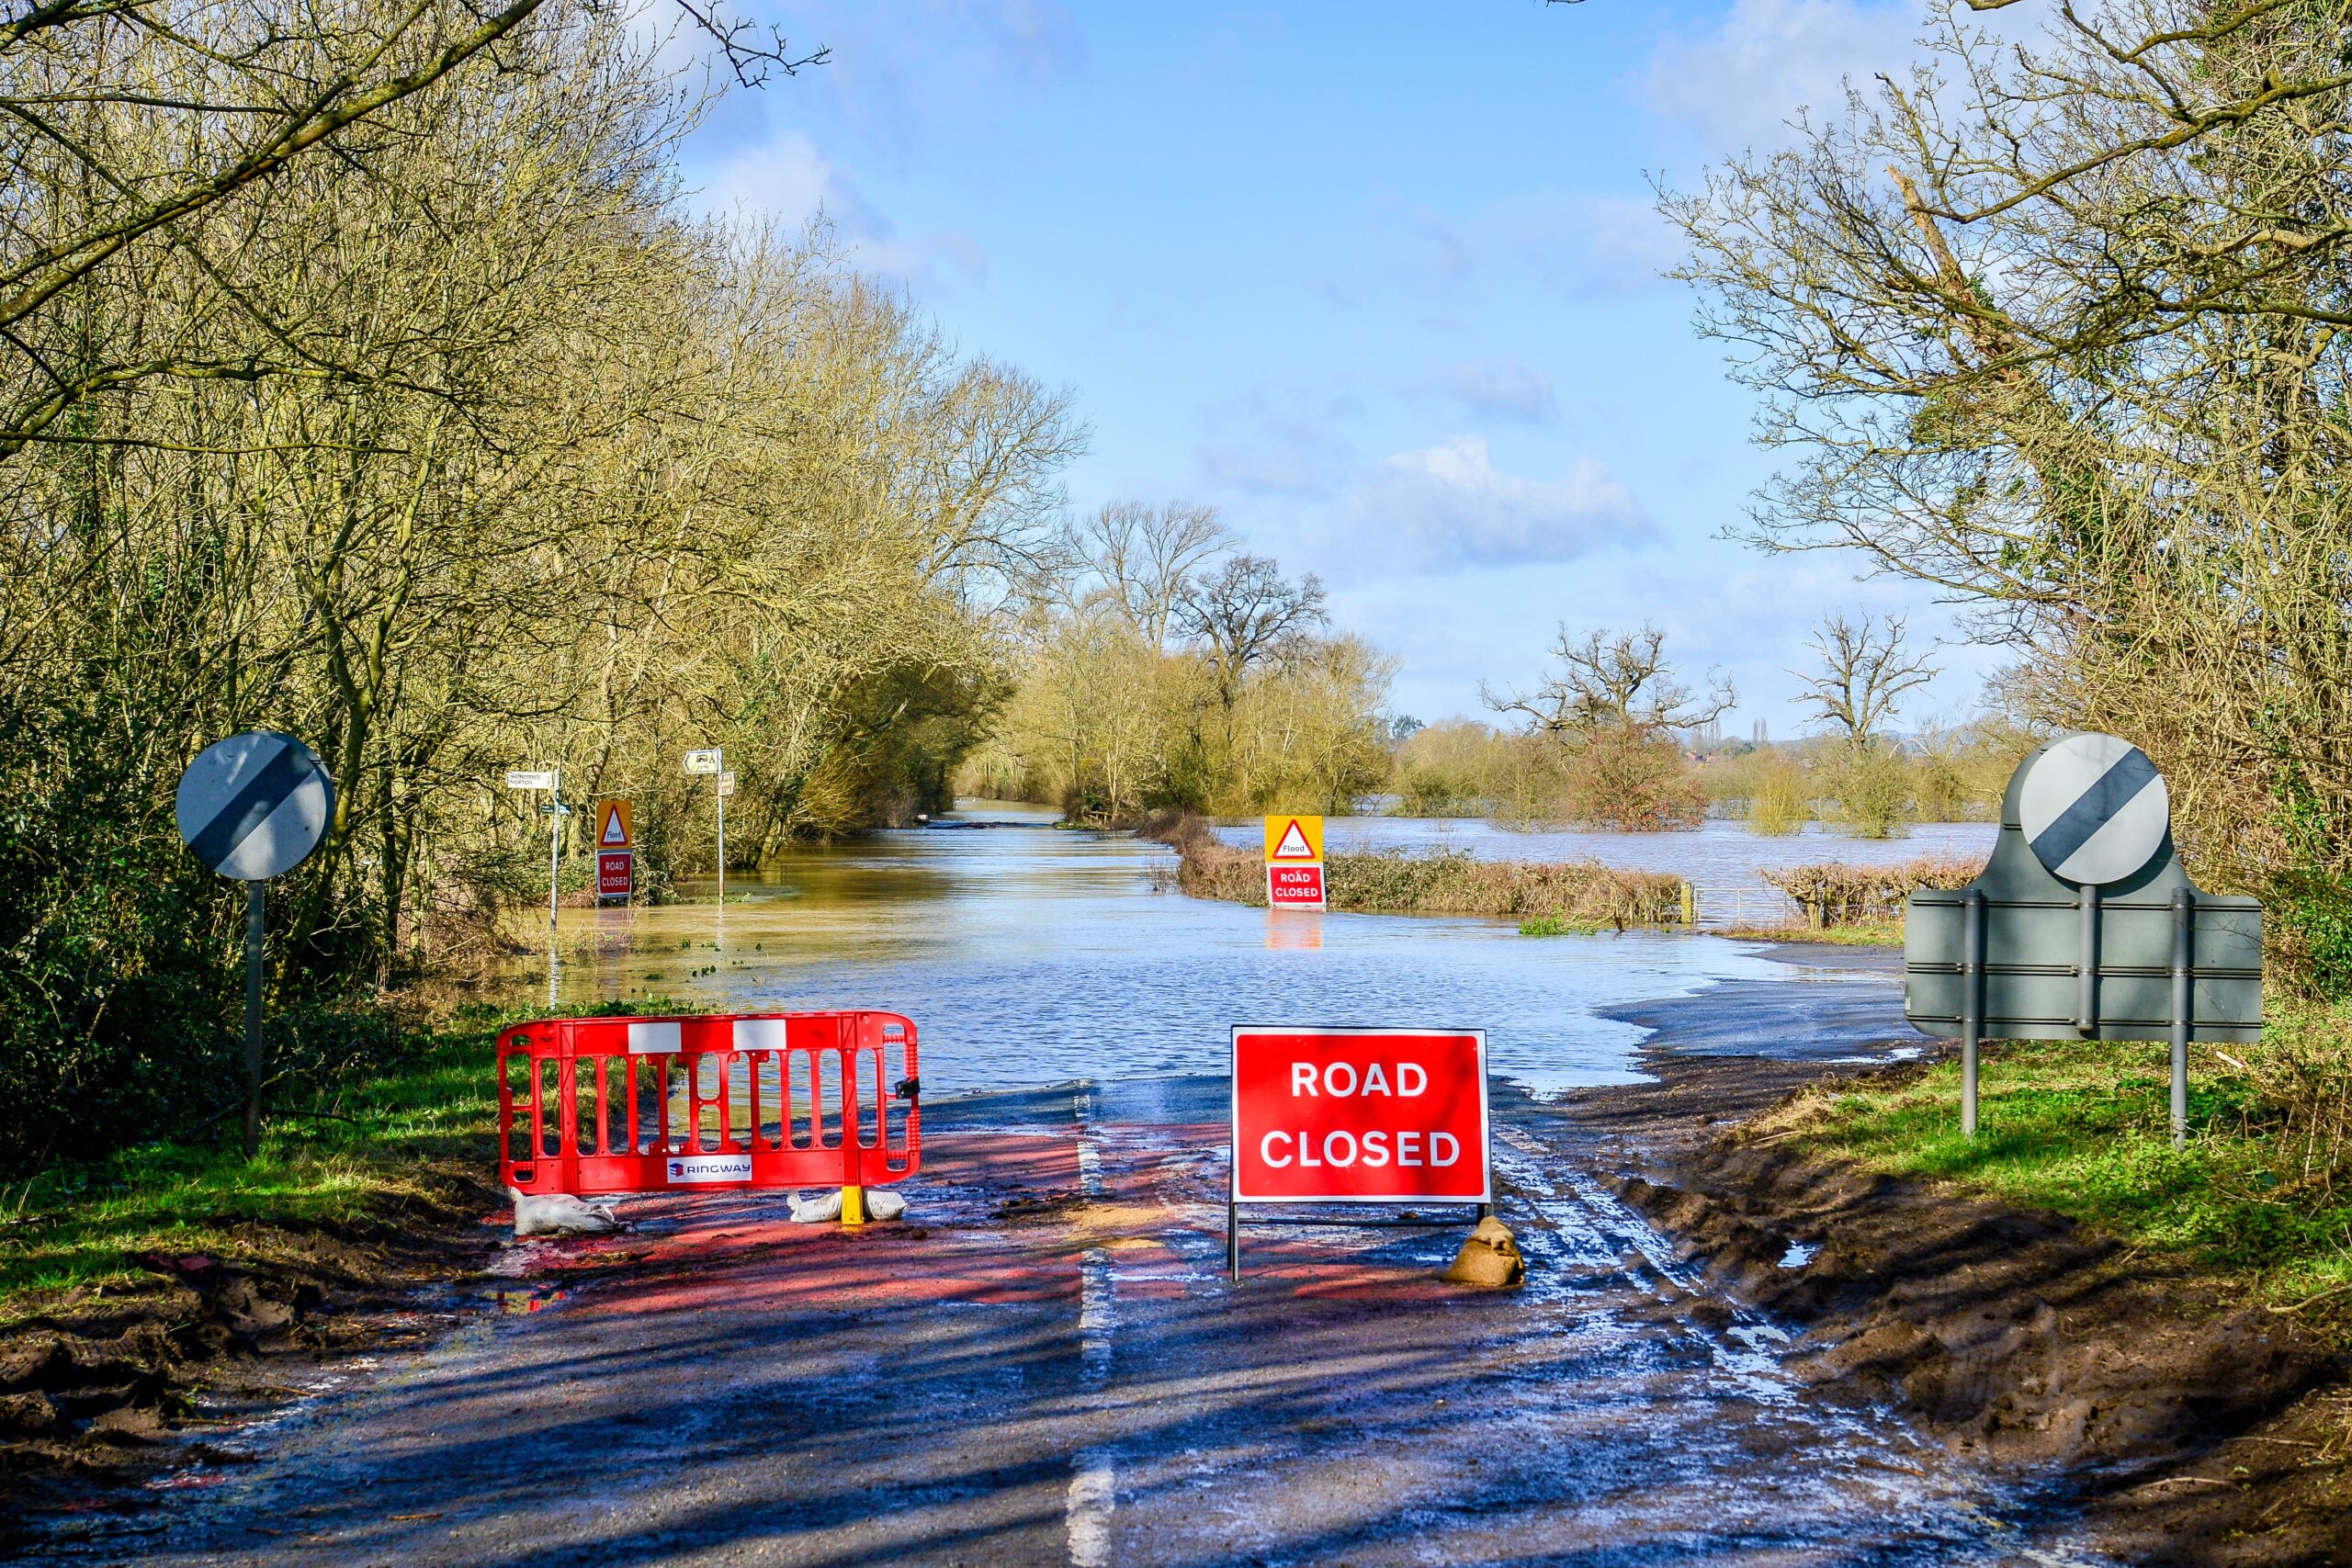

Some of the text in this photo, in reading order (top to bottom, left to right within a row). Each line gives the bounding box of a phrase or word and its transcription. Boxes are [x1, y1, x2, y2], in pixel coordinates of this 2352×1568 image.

[605, 861, 625, 871] ROAD
[602, 876, 628, 887] CLOSED
[1281, 874, 1310, 883] ROAD
[1275, 887, 1318, 897] CLOSED
[1291, 1062, 1428, 1098] ROAD
[1260, 1130, 1460, 1168] CLOSED
[687, 1164, 751, 1174] RINGWAY
